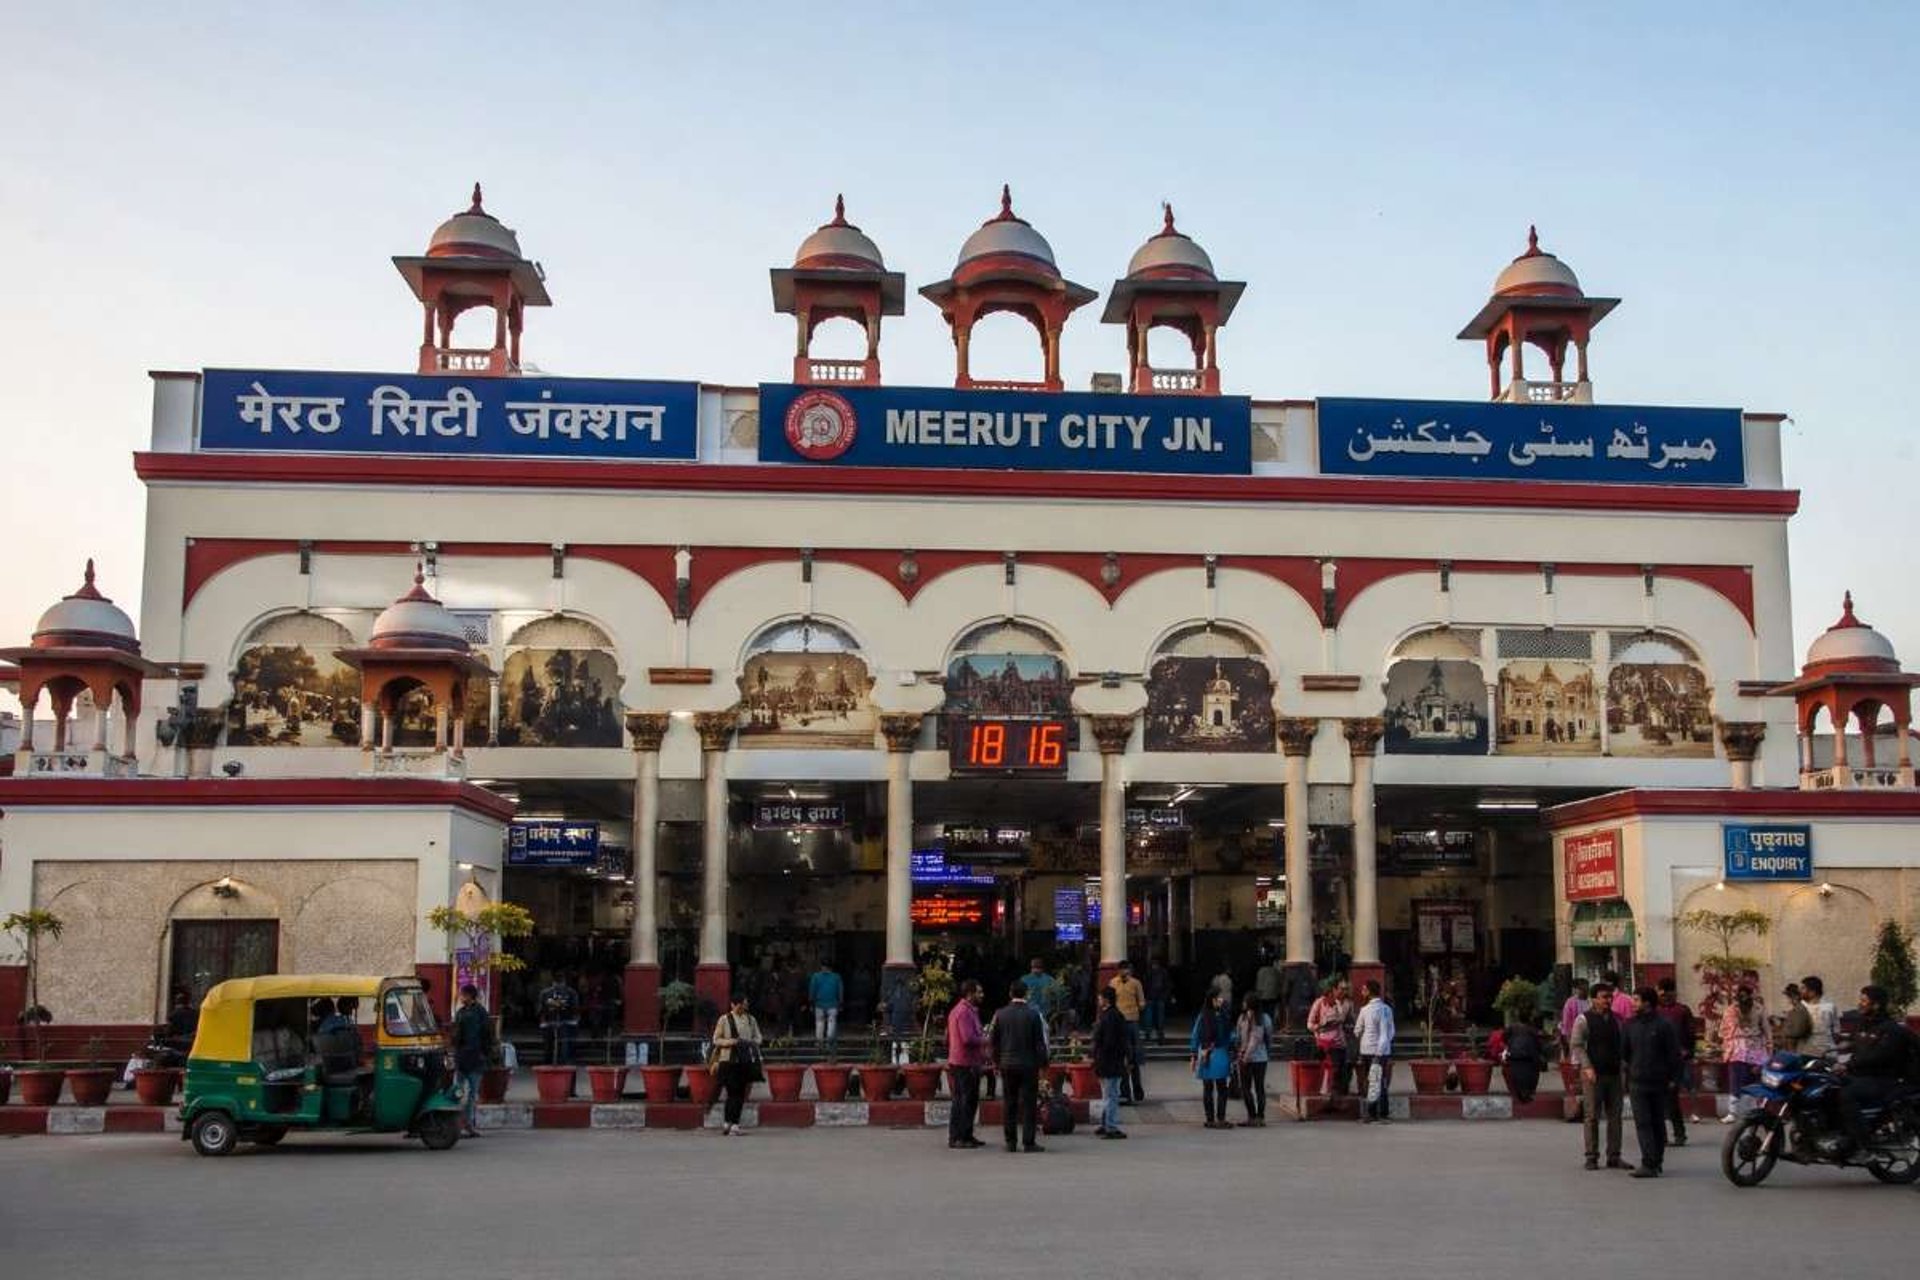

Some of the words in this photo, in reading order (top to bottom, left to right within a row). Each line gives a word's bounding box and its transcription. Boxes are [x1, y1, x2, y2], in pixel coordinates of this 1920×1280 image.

[236, 382, 345, 433] मेरठ
[368, 385, 482, 438] सिटी
[506, 391, 666, 442] जंक्शन
[885, 409, 1047, 448] MEERUT
[1060, 413, 1151, 450] CITY
[1162, 417, 1223, 452] JN.
[1348, 417, 1493, 462] جنکشن
[1508, 419, 1593, 466] سٹی
[1607, 422, 1718, 469] میرٹھ
[969, 725, 1005, 764] 18
[1028, 725, 1063, 765] 16
[1751, 857, 1806, 874] ENQUIRY
